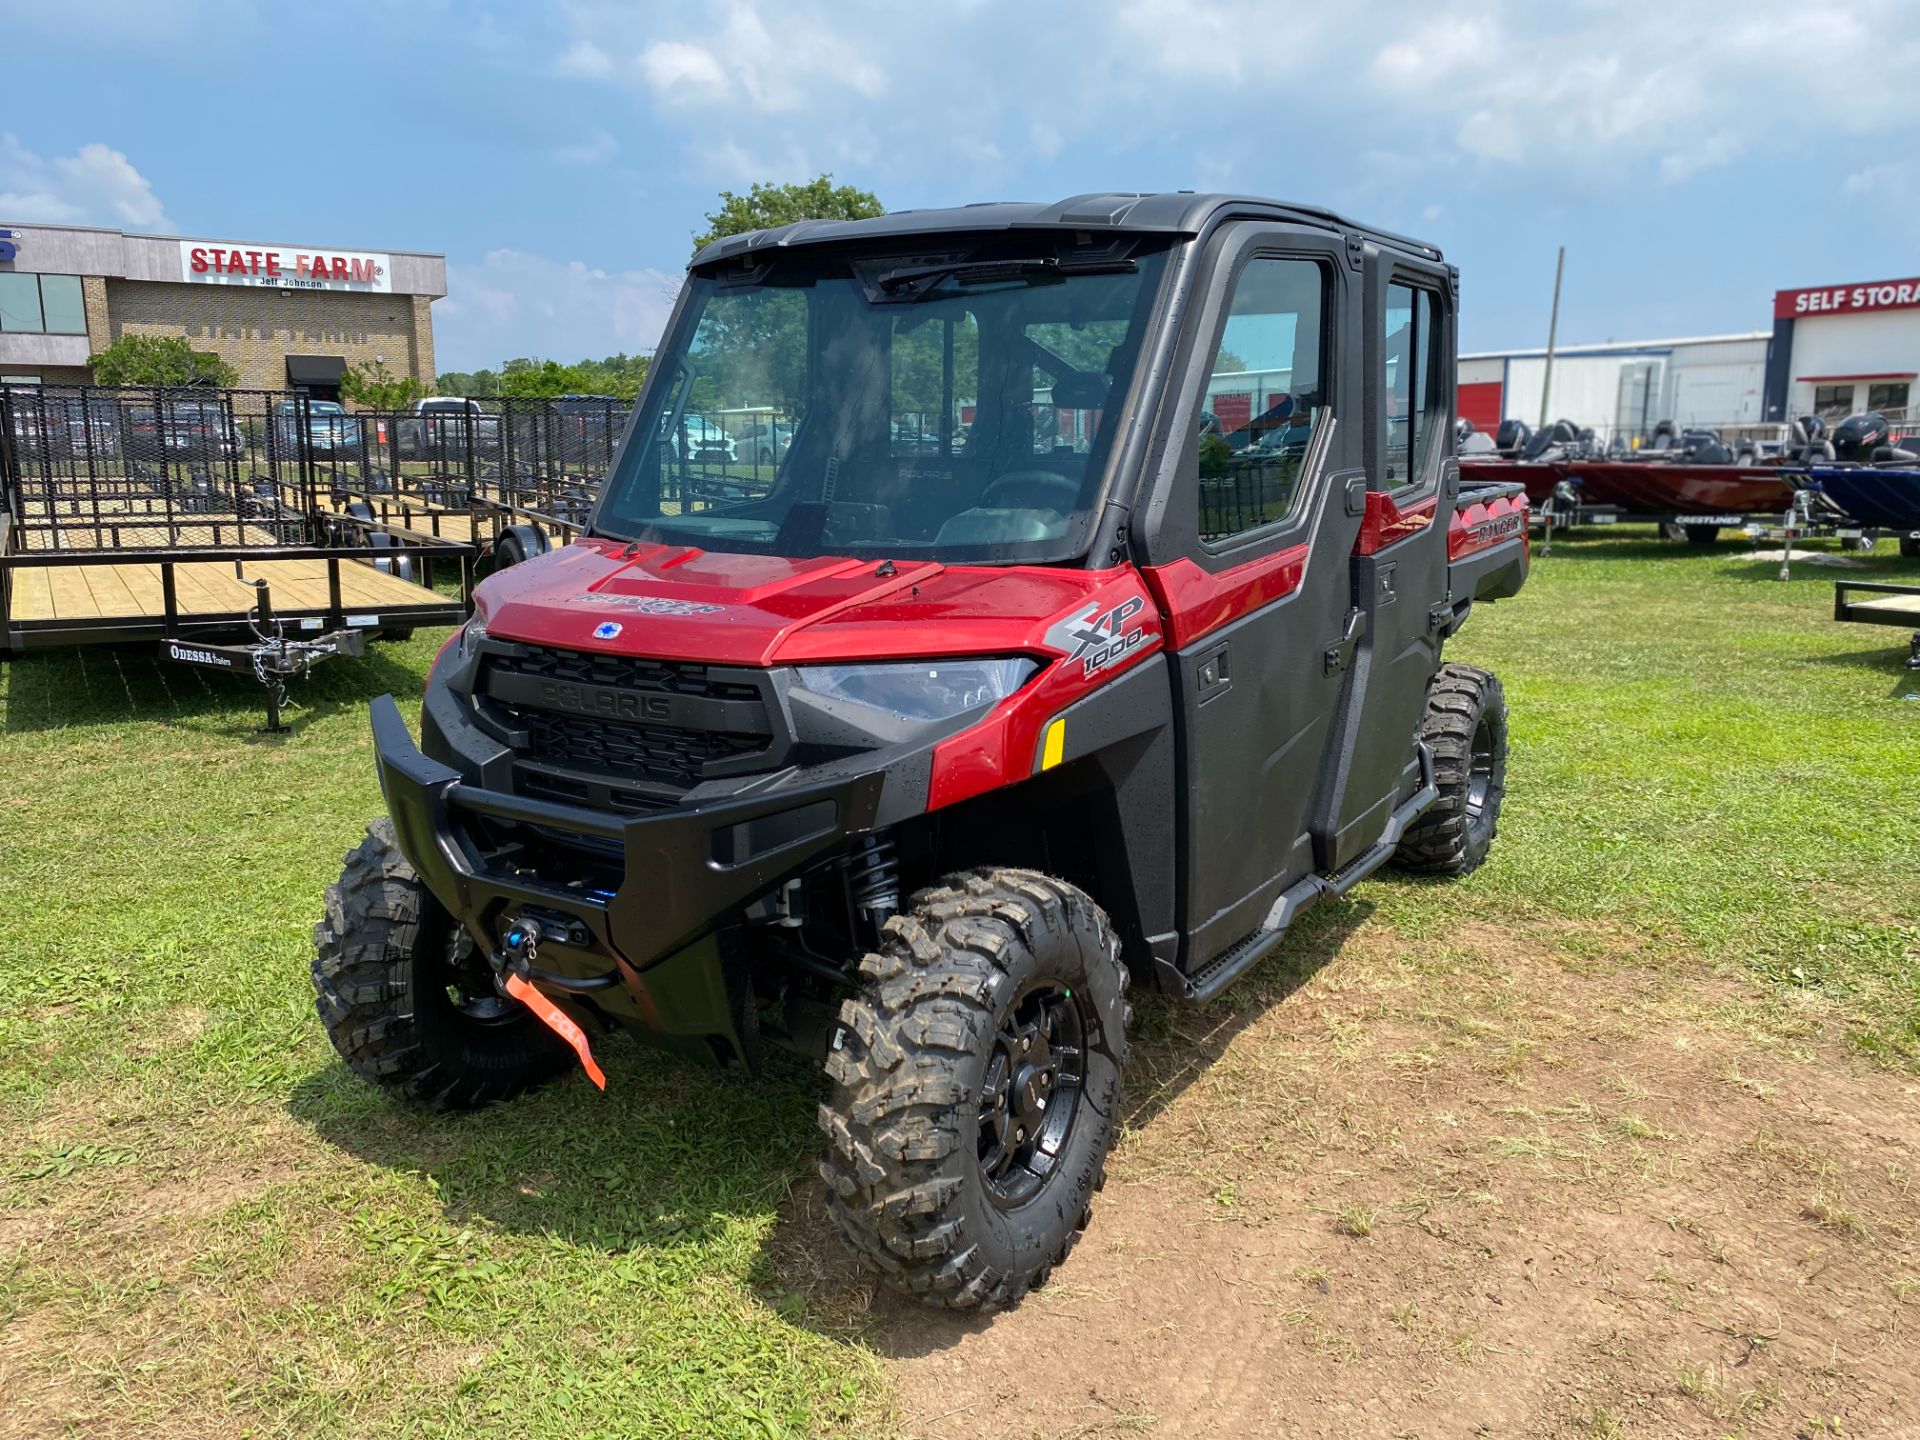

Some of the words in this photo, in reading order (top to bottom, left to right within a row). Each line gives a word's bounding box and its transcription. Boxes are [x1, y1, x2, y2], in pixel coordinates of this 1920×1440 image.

[190, 248, 282, 276] STATE
[260, 277, 278, 286] Jeff
[283, 278, 322, 288] Johnson
[1795, 290, 1846, 312] SELF
[1479, 516, 1520, 542] RANGER
[1675, 515, 1742, 525] CRESTLINER
[1062, 595, 1144, 668] XP
[170, 644, 213, 664] ODESSA
[1083, 626, 1142, 675] 1000
[541, 682, 670, 722] POLARIS
